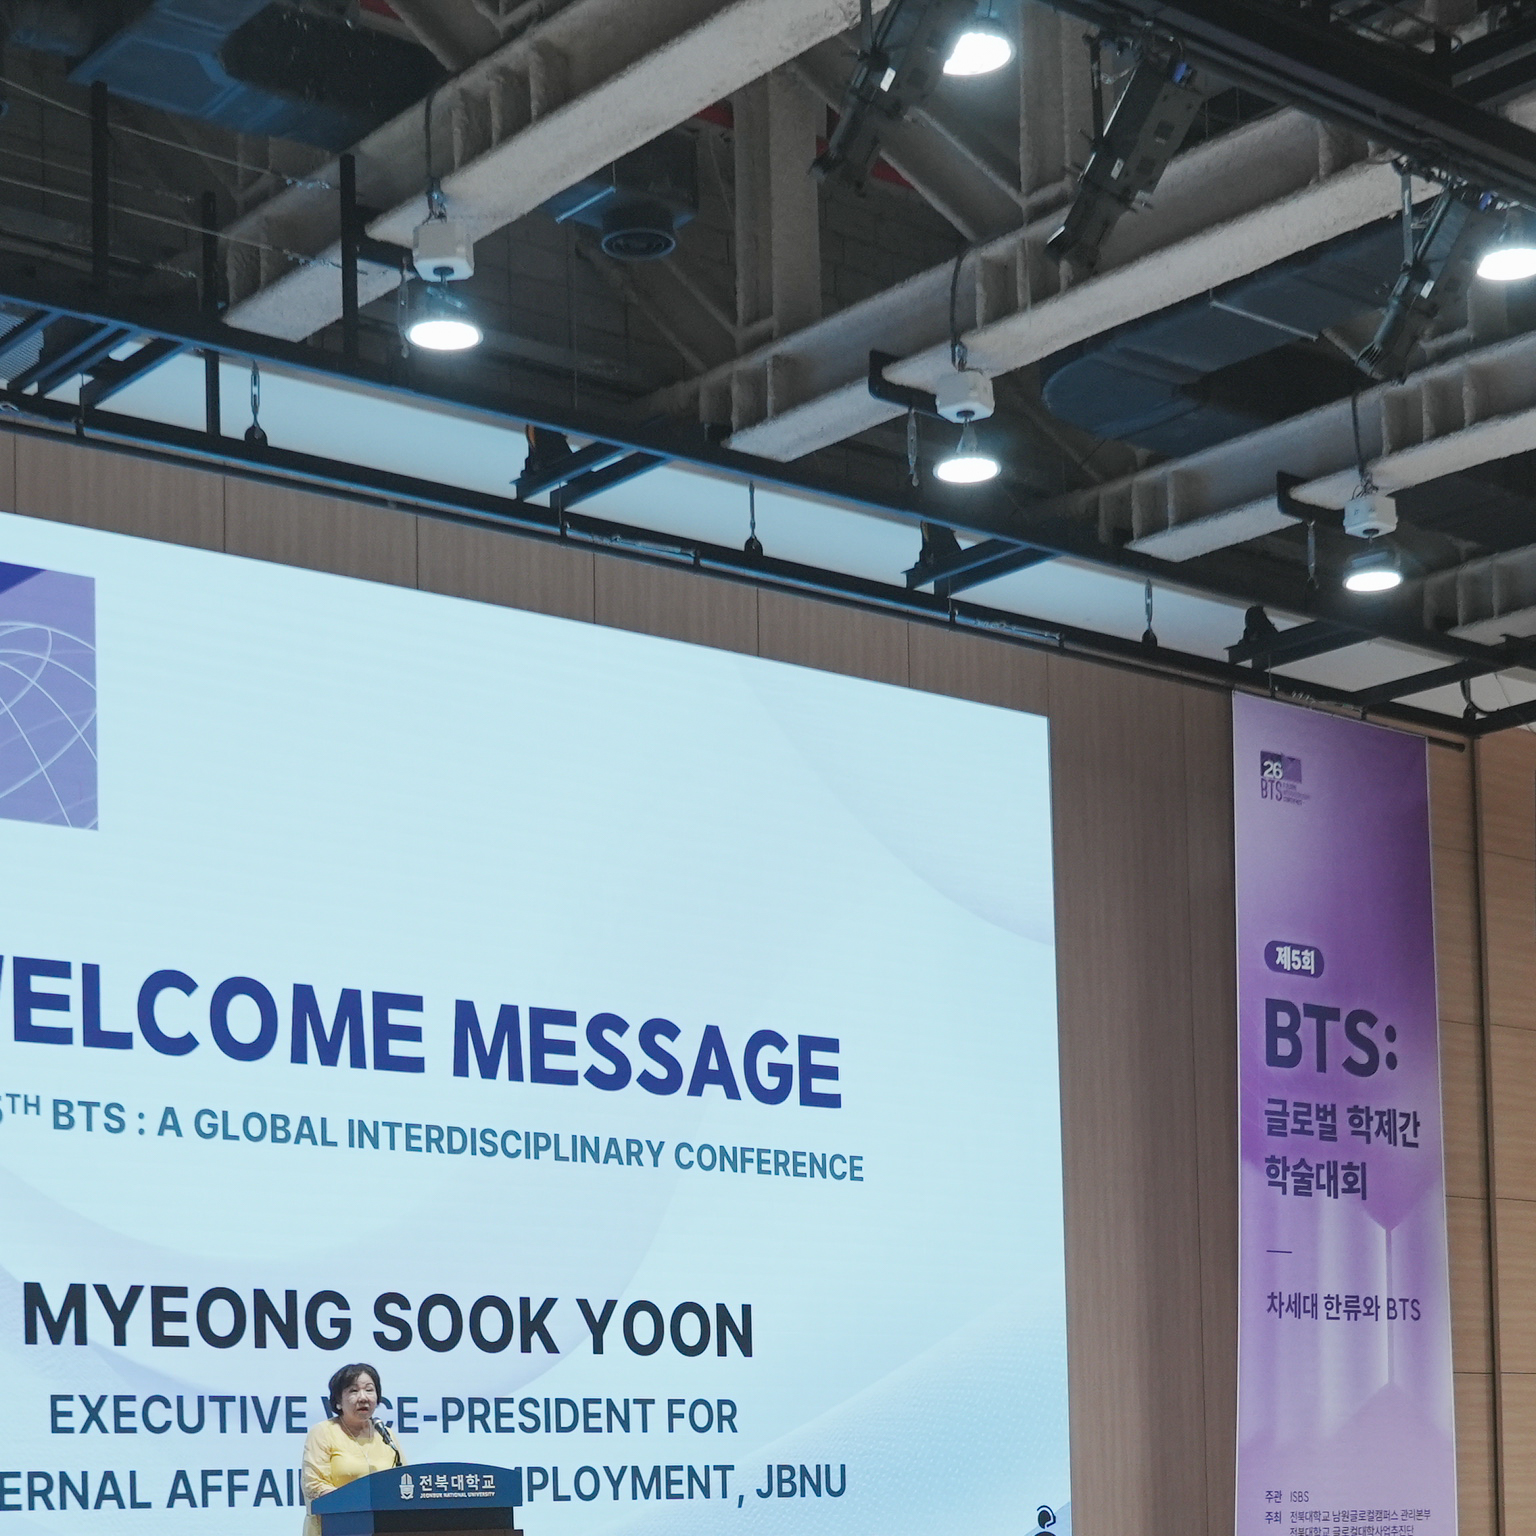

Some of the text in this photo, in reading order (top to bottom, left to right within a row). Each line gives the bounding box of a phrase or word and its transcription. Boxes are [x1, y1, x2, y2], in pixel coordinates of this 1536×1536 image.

[1260, 779, 1283, 801] BTS
[1263, 760, 1284, 780] 26
[1275, 946, 1315, 975] 제5회
[453, 999, 841, 1108] MESSAGE
[1265, 998, 1398, 1077] BTS:
[52, 1098, 126, 1134] BTS
[156, 1107, 183, 1138] A
[193, 1107, 338, 1148] GLOBAL
[347, 1120, 664, 1167] INTERDISCIPLINARY
[673, 1141, 864, 1182] CONFERENCE
[1264, 1098, 1421, 1148] 글로벌 학제간
[1265, 1155, 1367, 1200] 학술대회
[22, 1281, 753, 1359] MYEONG SOOK YOON
[1266, 1291, 1422, 1323] 차세대 한류와 BTS
[51, 1395, 738, 1435] EXECUTIVE E-PRESIDENT FOR
[166, 1469, 306, 1508] AFFAI
[515, 1465, 745, 1508] PLOYMENT,
[755, 1464, 847, 1498] JBNU
[419, 1473, 496, 1491] 전북대학교
[1265, 1490, 1309, 1504] 주관 ISBS
[1265, 1511, 1282, 1525] 주최
[1290, 1510, 1330, 1524] 전북대학교
